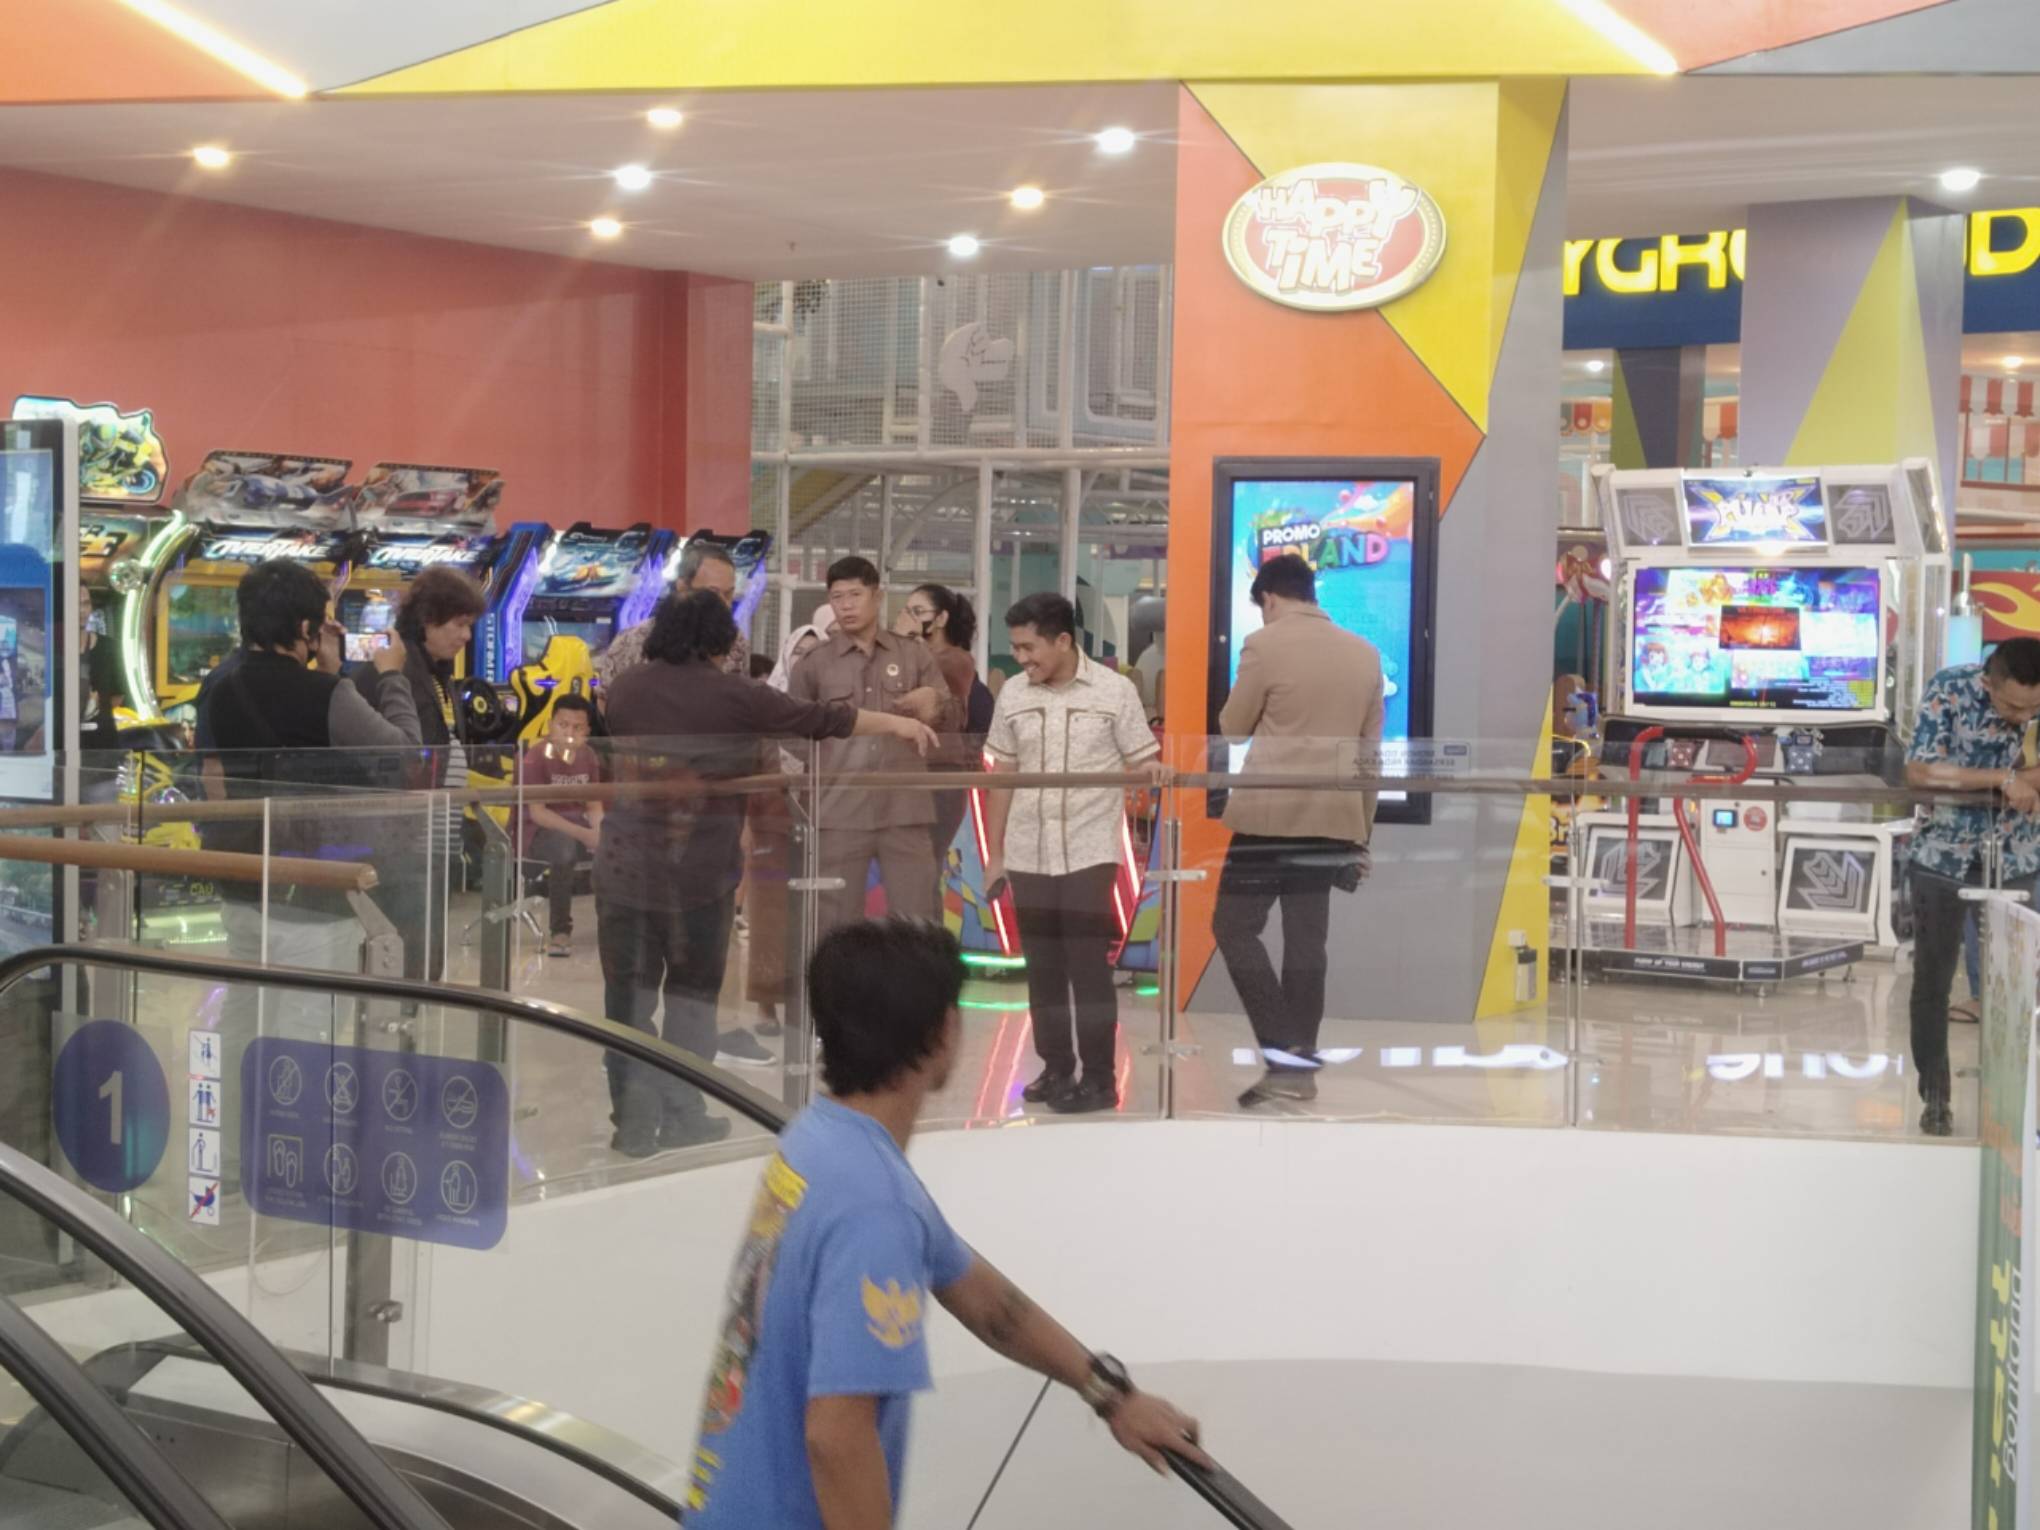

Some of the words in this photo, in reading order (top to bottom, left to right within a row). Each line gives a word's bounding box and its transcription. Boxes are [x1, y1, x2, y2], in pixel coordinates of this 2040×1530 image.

[1256, 178, 1420, 238] HAPPY
[1264, 227, 1382, 295] TIME
[203, 538, 331, 562] OVERTAKE
[367, 543, 480, 567] OVERTAKE
[1262, 524, 1321, 546] PROMO
[99, 1069, 123, 1145] 1
